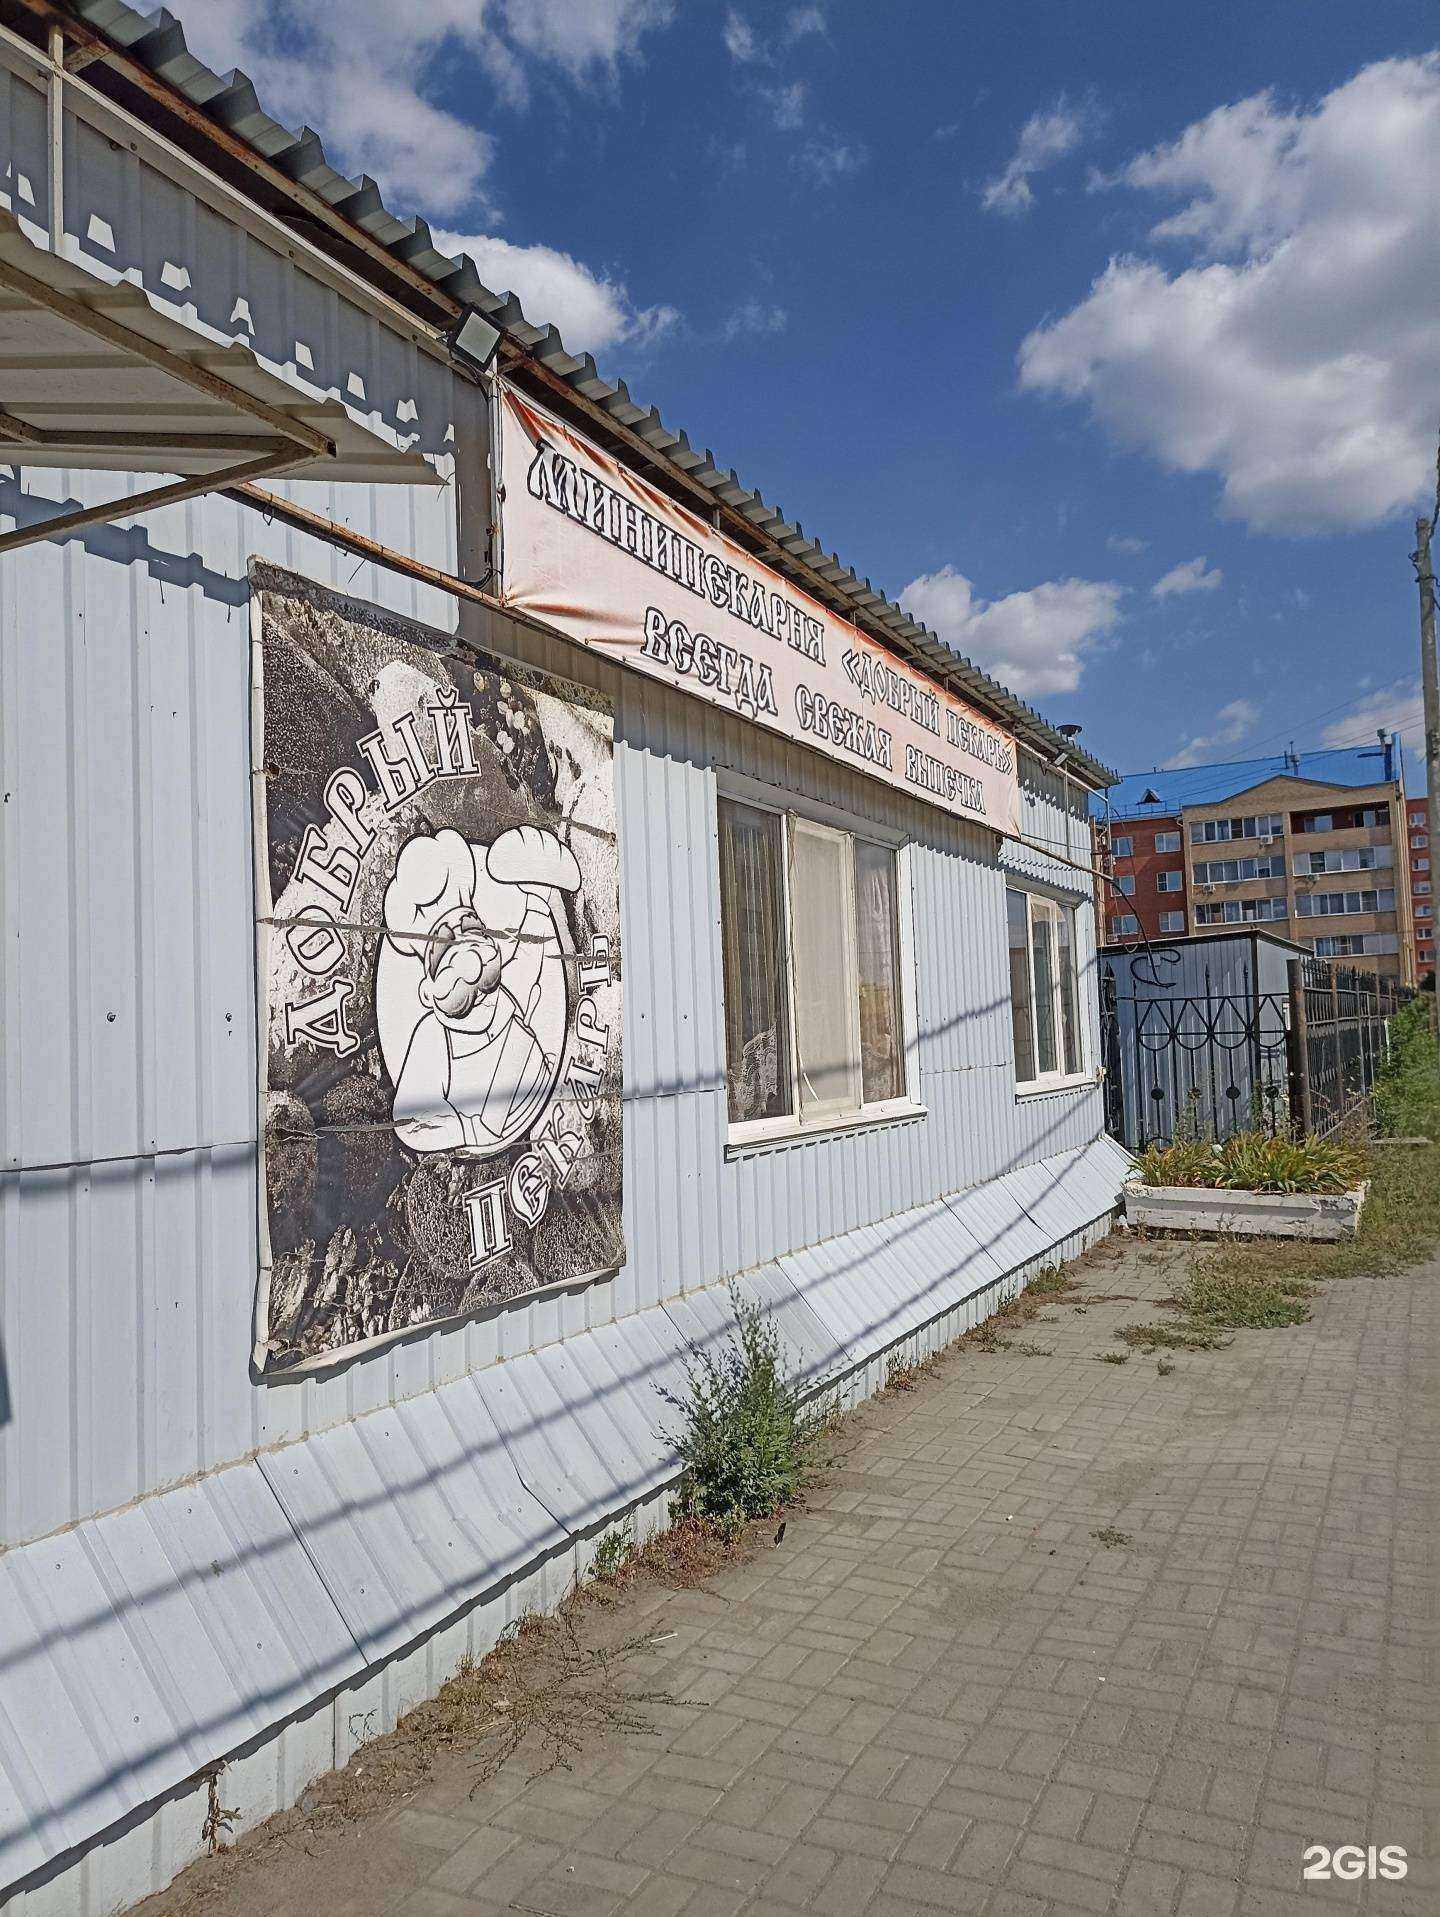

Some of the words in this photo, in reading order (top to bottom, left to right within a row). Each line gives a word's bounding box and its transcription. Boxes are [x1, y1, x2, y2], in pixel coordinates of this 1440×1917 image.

[281, 687, 481, 1058] ДОБРЫЙ
[640, 606, 778, 721] ВСЕГДА
[795, 684, 893, 772] СВЕЖАЯ
[905, 744, 987, 815] ВЫПЕЧКА
[461, 932, 612, 1273] ПЕКАРЬ
